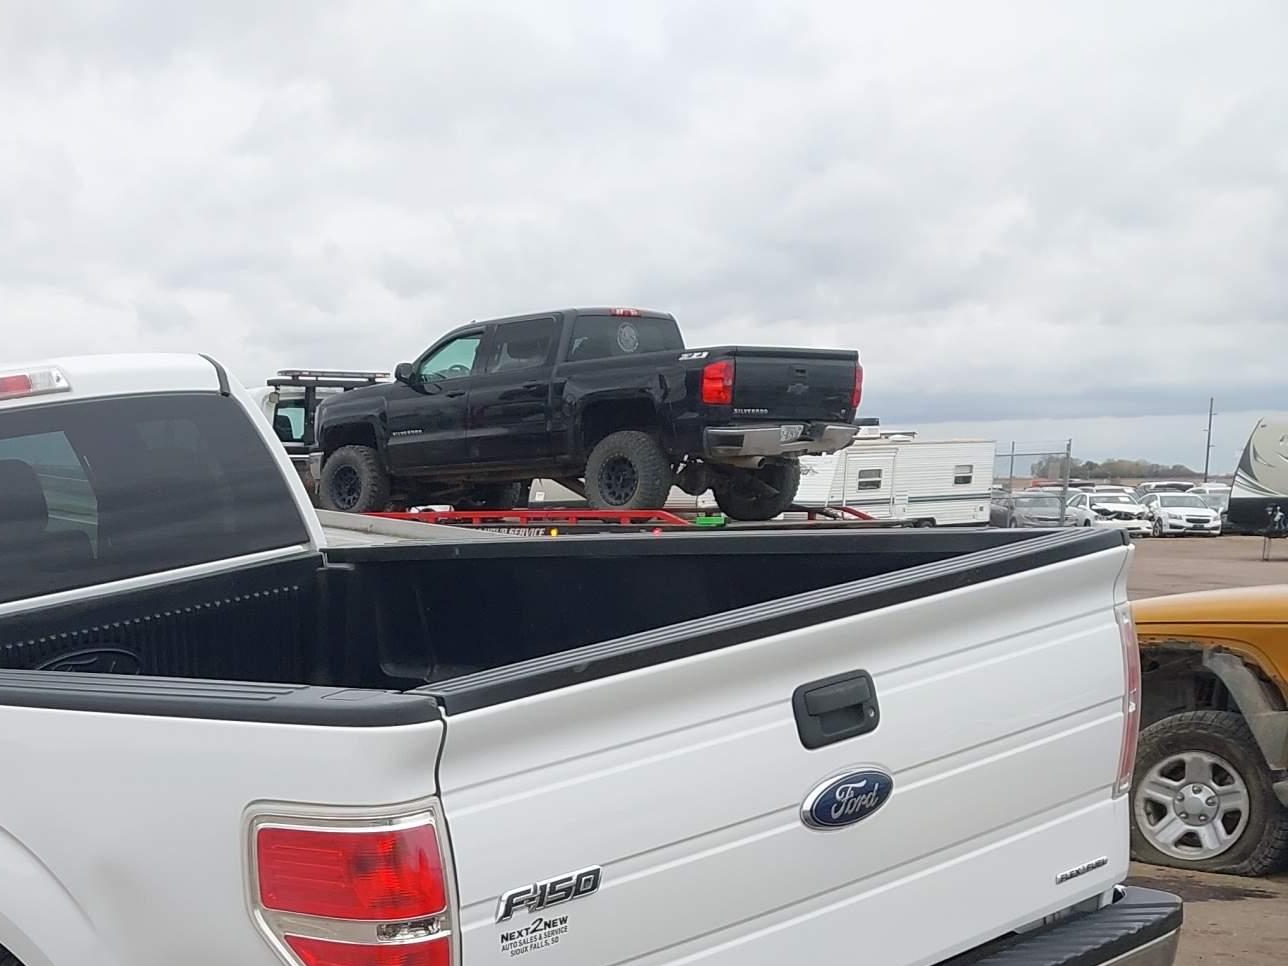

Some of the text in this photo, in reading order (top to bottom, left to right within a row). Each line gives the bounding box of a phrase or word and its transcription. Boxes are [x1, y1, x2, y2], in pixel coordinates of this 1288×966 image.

[831, 779, 879, 819] Ford
[501, 940, 517, 952] AUTO
[518, 935, 537, 947] SALES
[544, 926, 568, 939] SERVICE
[510, 946, 529, 957] SIOUX
[551, 936, 559, 944] SD
